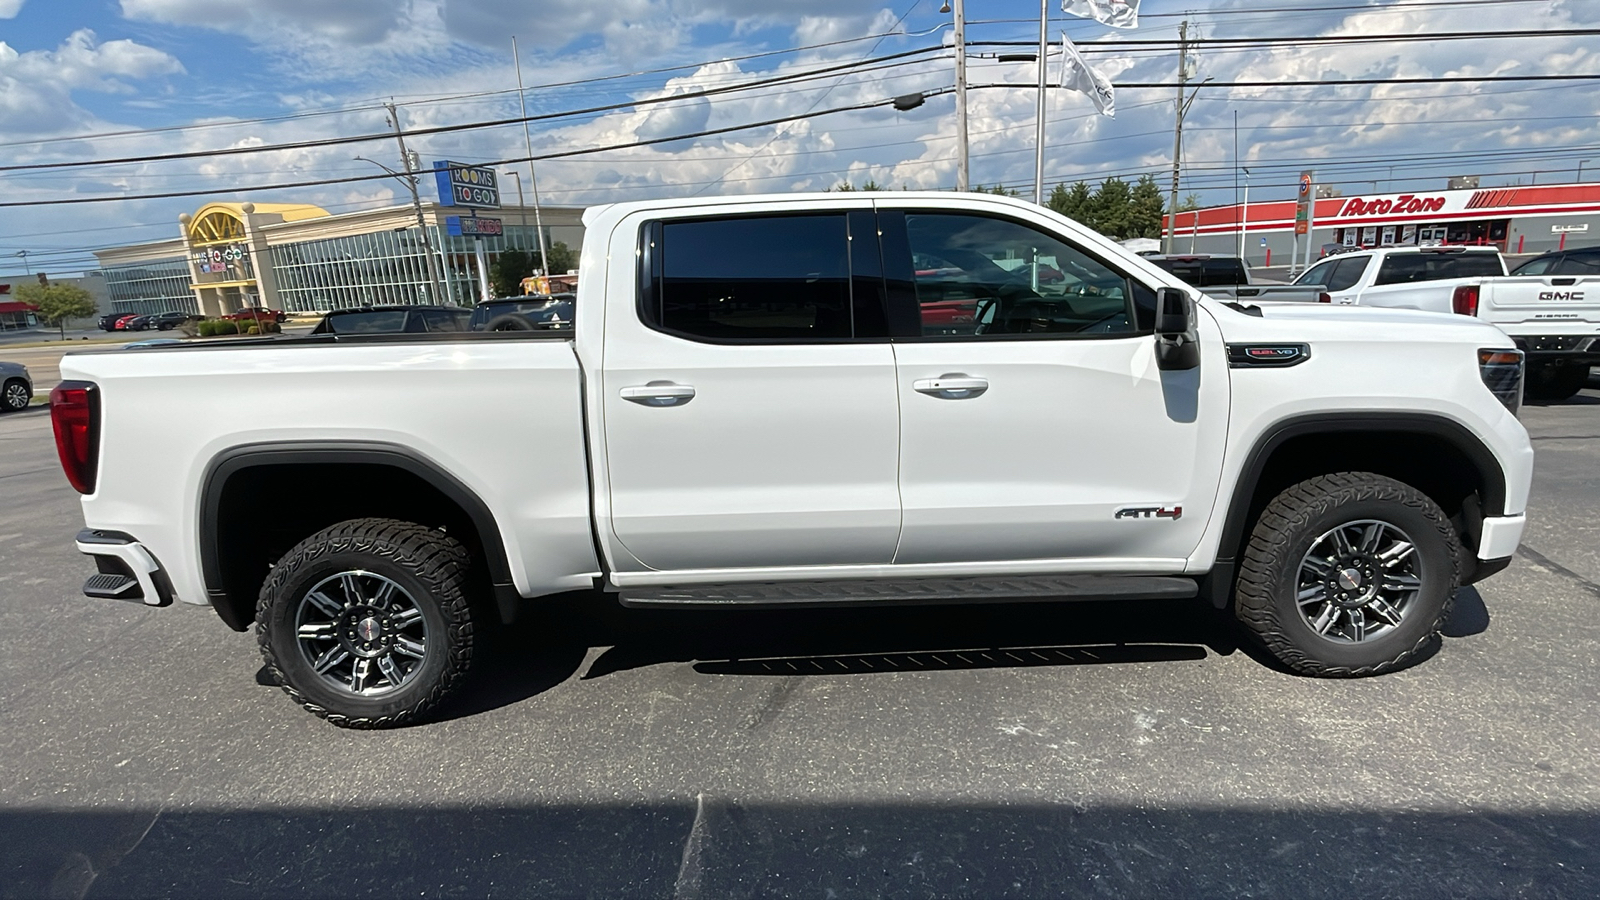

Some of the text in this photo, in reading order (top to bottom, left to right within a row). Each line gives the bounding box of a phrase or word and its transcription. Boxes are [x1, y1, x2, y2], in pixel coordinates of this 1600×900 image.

[454, 168, 493, 186] ROOMS
[457, 187, 490, 203] TO GO
[1539, 292, 1584, 300] GMC
[1115, 506, 1183, 521] AT4
